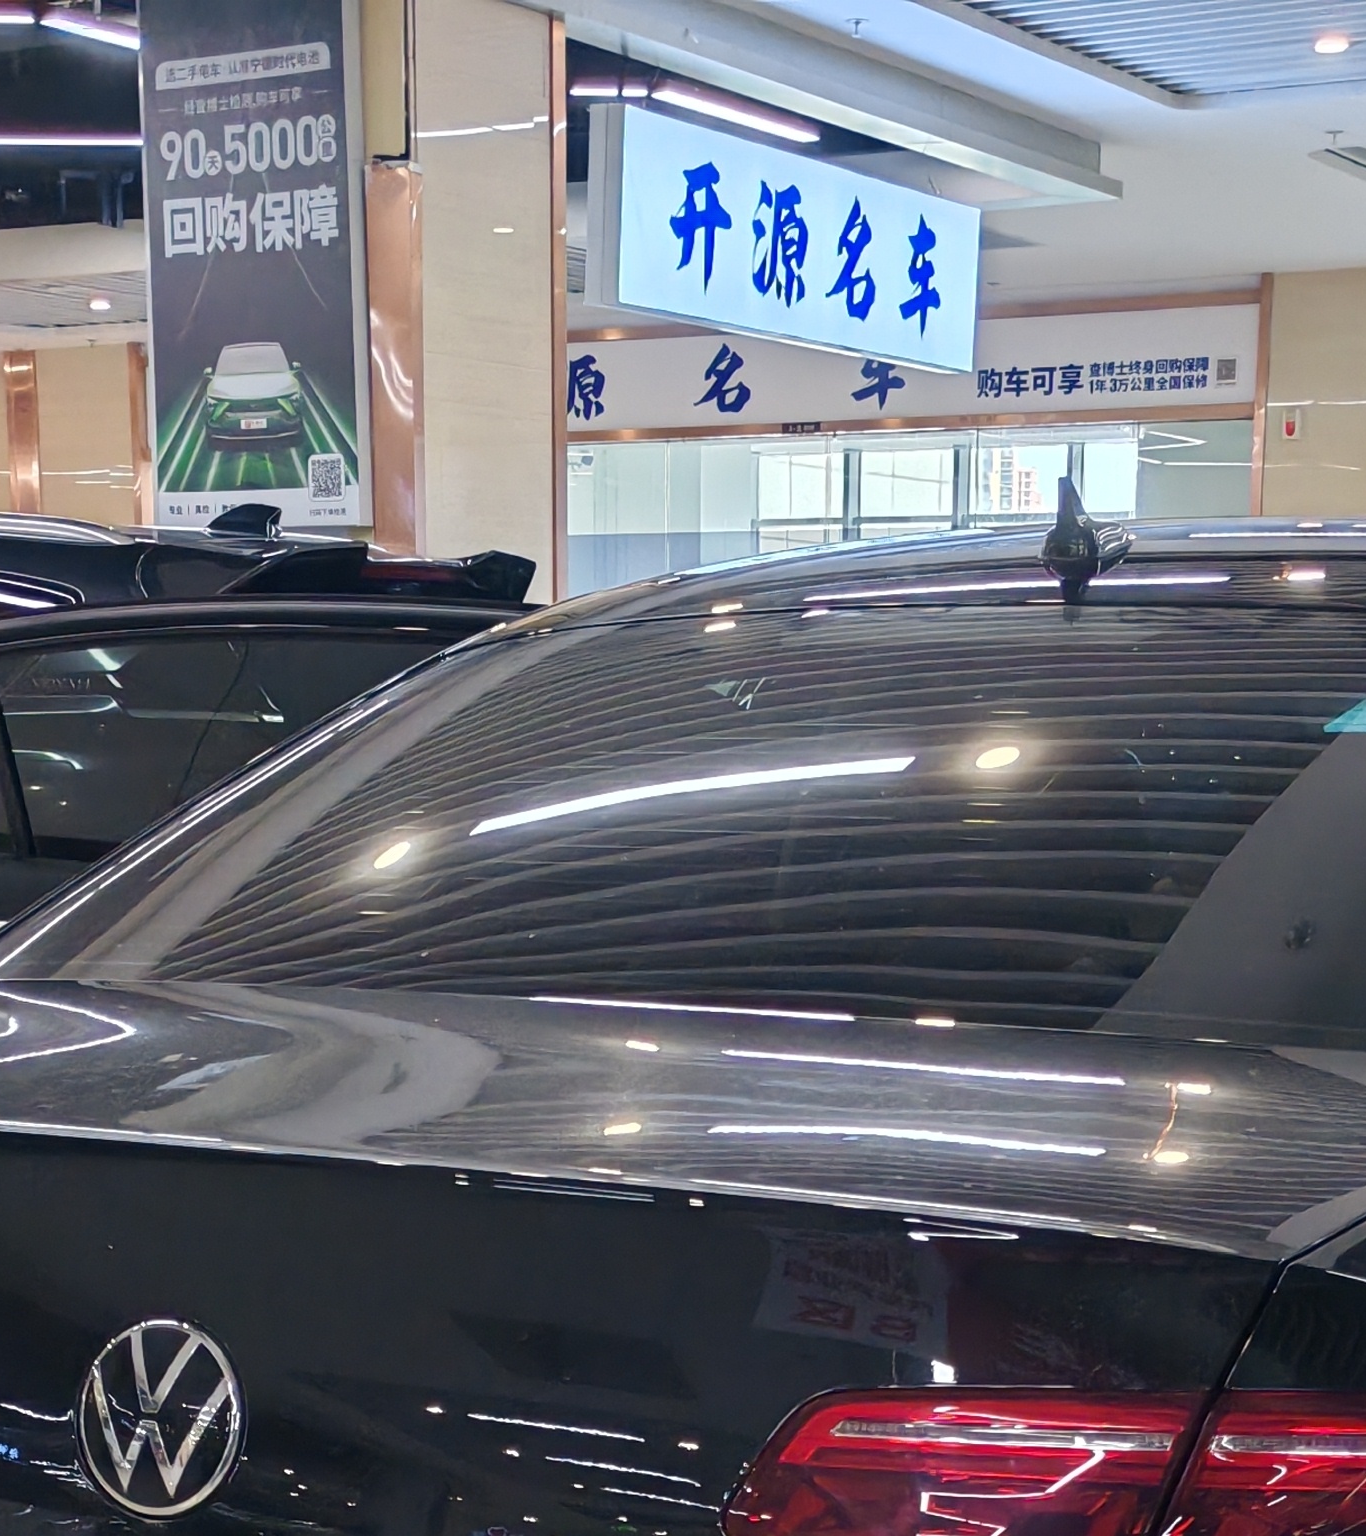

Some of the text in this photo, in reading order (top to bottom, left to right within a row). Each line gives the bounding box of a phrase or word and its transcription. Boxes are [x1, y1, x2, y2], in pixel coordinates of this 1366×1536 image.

[162, 182, 340, 259] 回购保障
[669, 161, 941, 341] 开源名车
[977, 363, 1085, 399] 购车可享
[1088, 356, 1210, 379] 查博士终身回购保障
